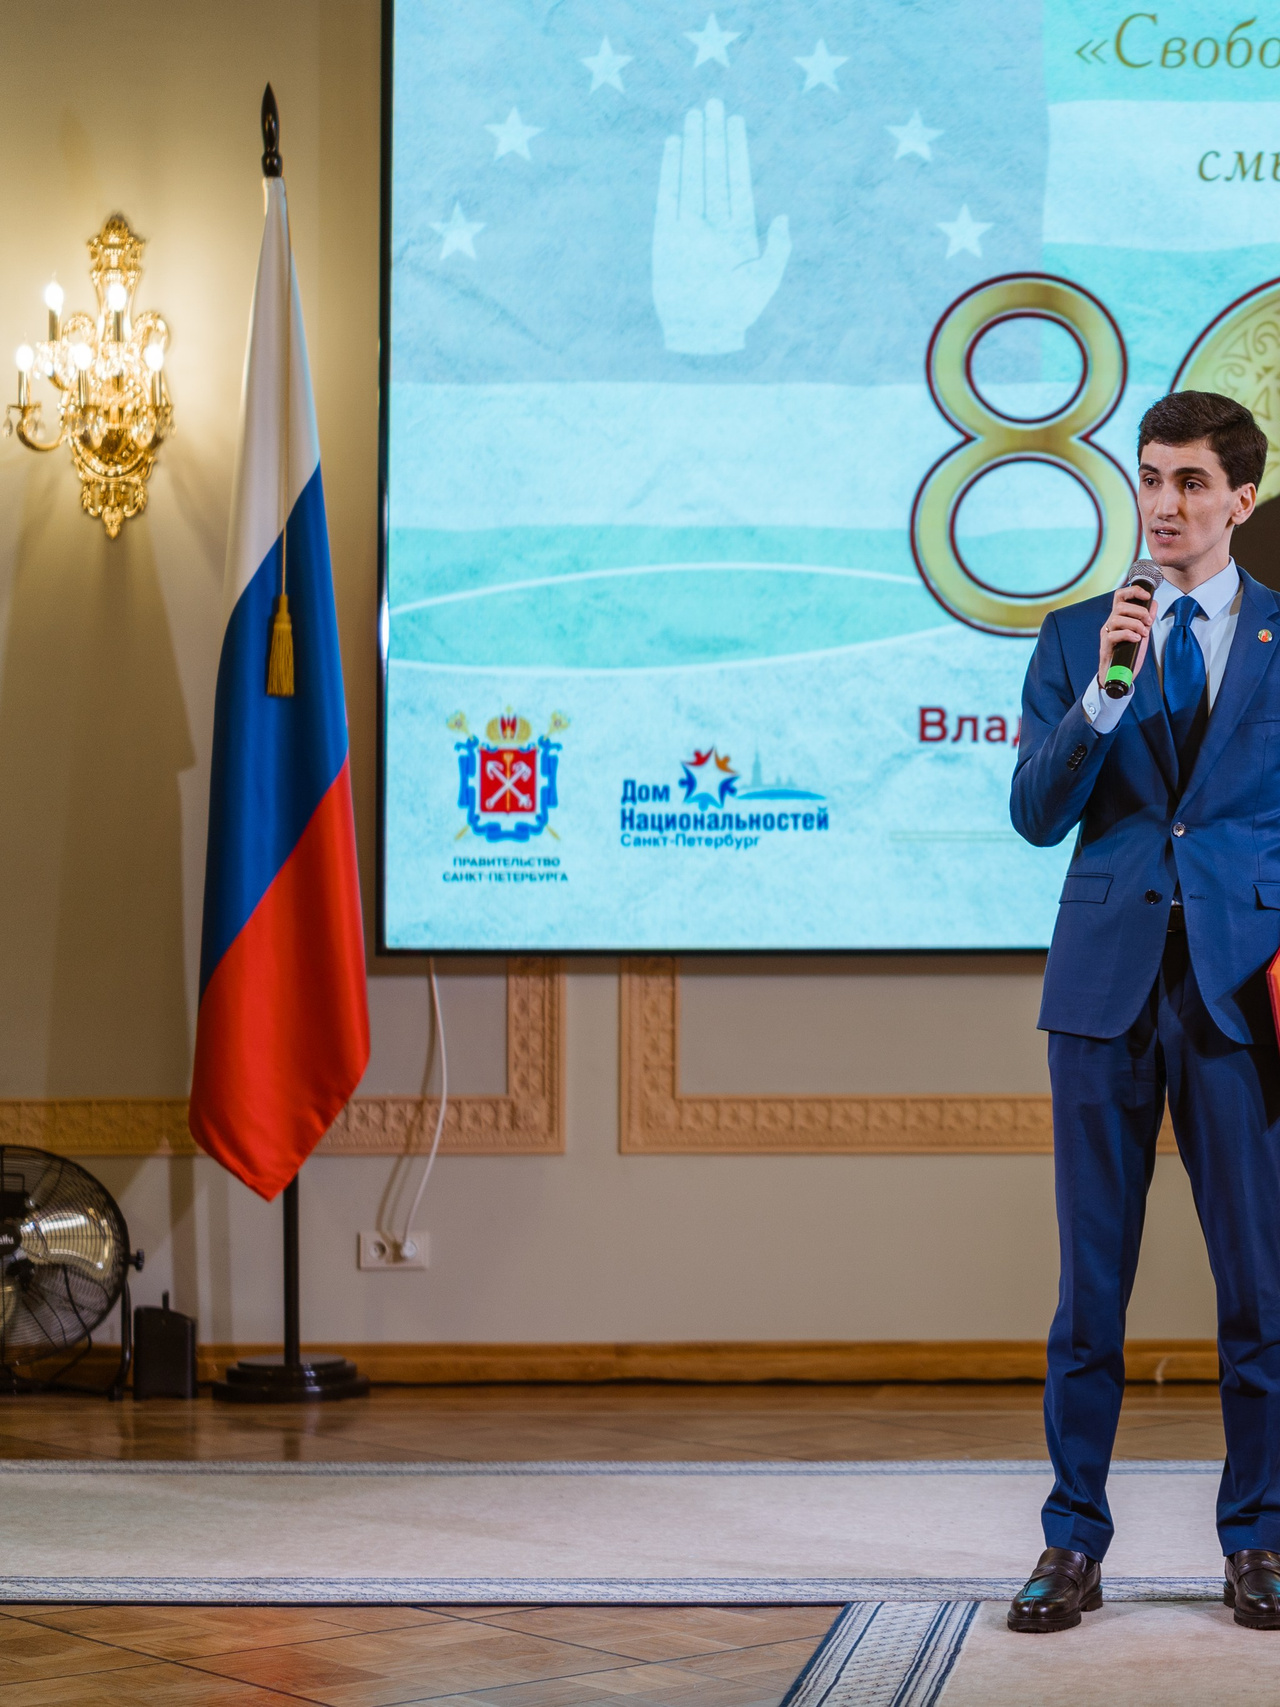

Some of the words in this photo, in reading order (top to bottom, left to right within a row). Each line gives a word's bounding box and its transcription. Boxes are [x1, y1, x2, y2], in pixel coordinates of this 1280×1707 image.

[918, 706, 1021, 748] Вла
[620, 779, 671, 806] Дом
[620, 806, 830, 834] Национальностей
[620, 833, 760, 850] Санкт-Петербург
[453, 856, 561, 868] ПРАВИТЕЛЬСТВО
[442, 871, 569, 883] САНКТ-ПЕТЕРБУРГА
